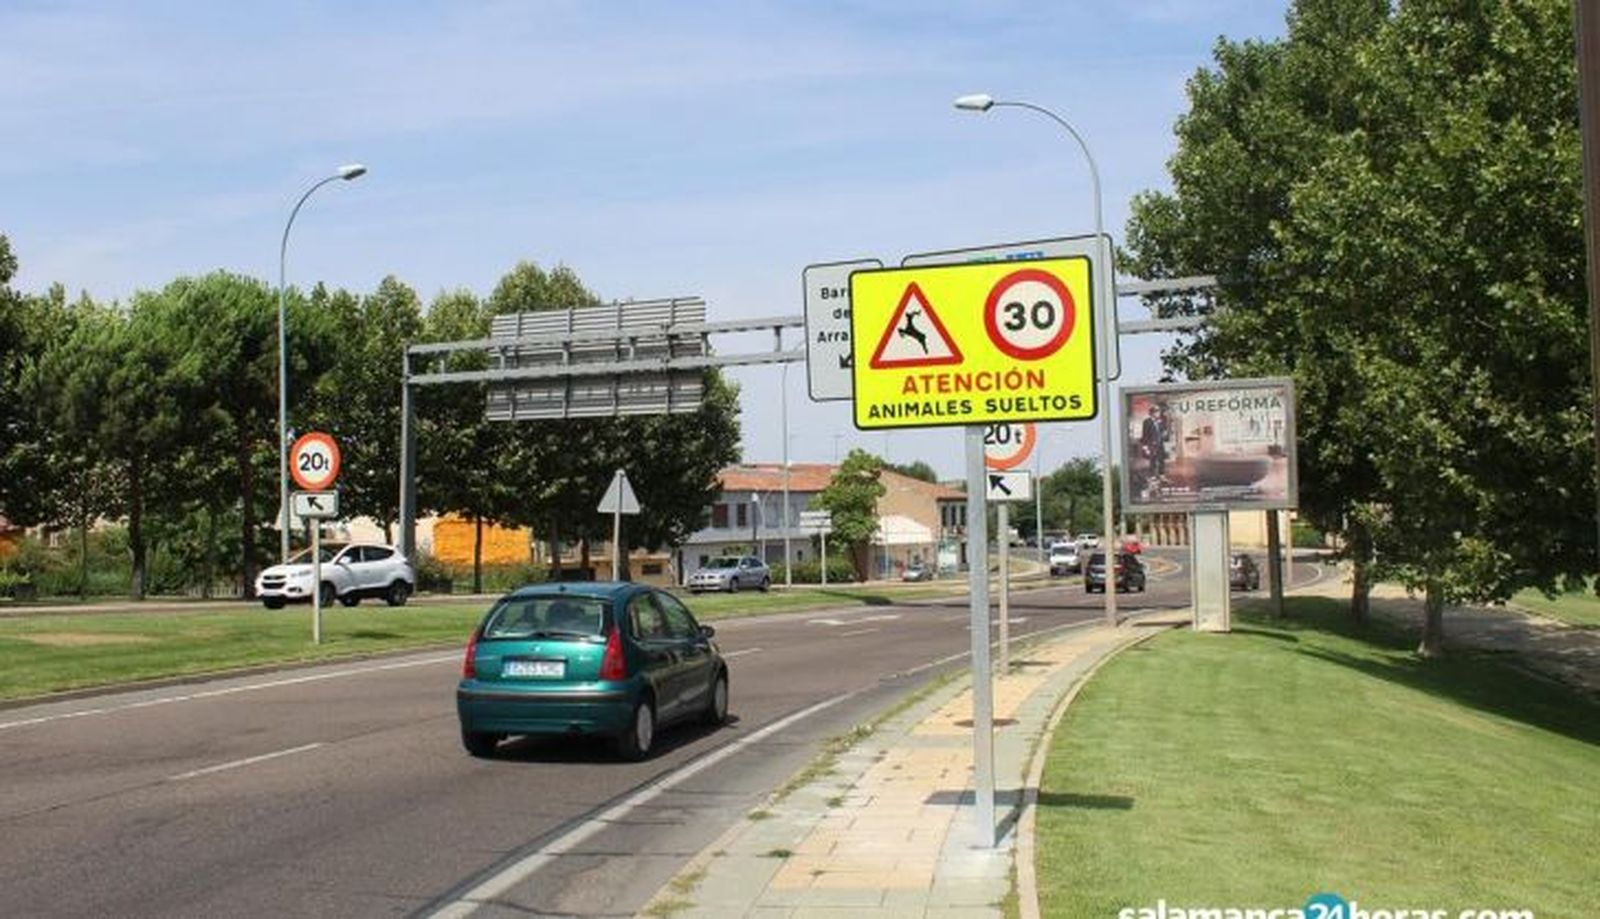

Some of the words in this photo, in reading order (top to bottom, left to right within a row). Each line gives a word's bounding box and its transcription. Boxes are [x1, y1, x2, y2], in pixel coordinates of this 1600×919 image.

[1004, 300, 1055, 330] 30
[817, 331, 849, 343] Arra
[902, 367, 1045, 395] ATENCIÓN
[868, 399, 972, 419] ANIMALES
[985, 394, 1082, 413] SUELTOS
[1195, 397, 1281, 412] REFORMA
[299, 452, 329, 471] 20t
